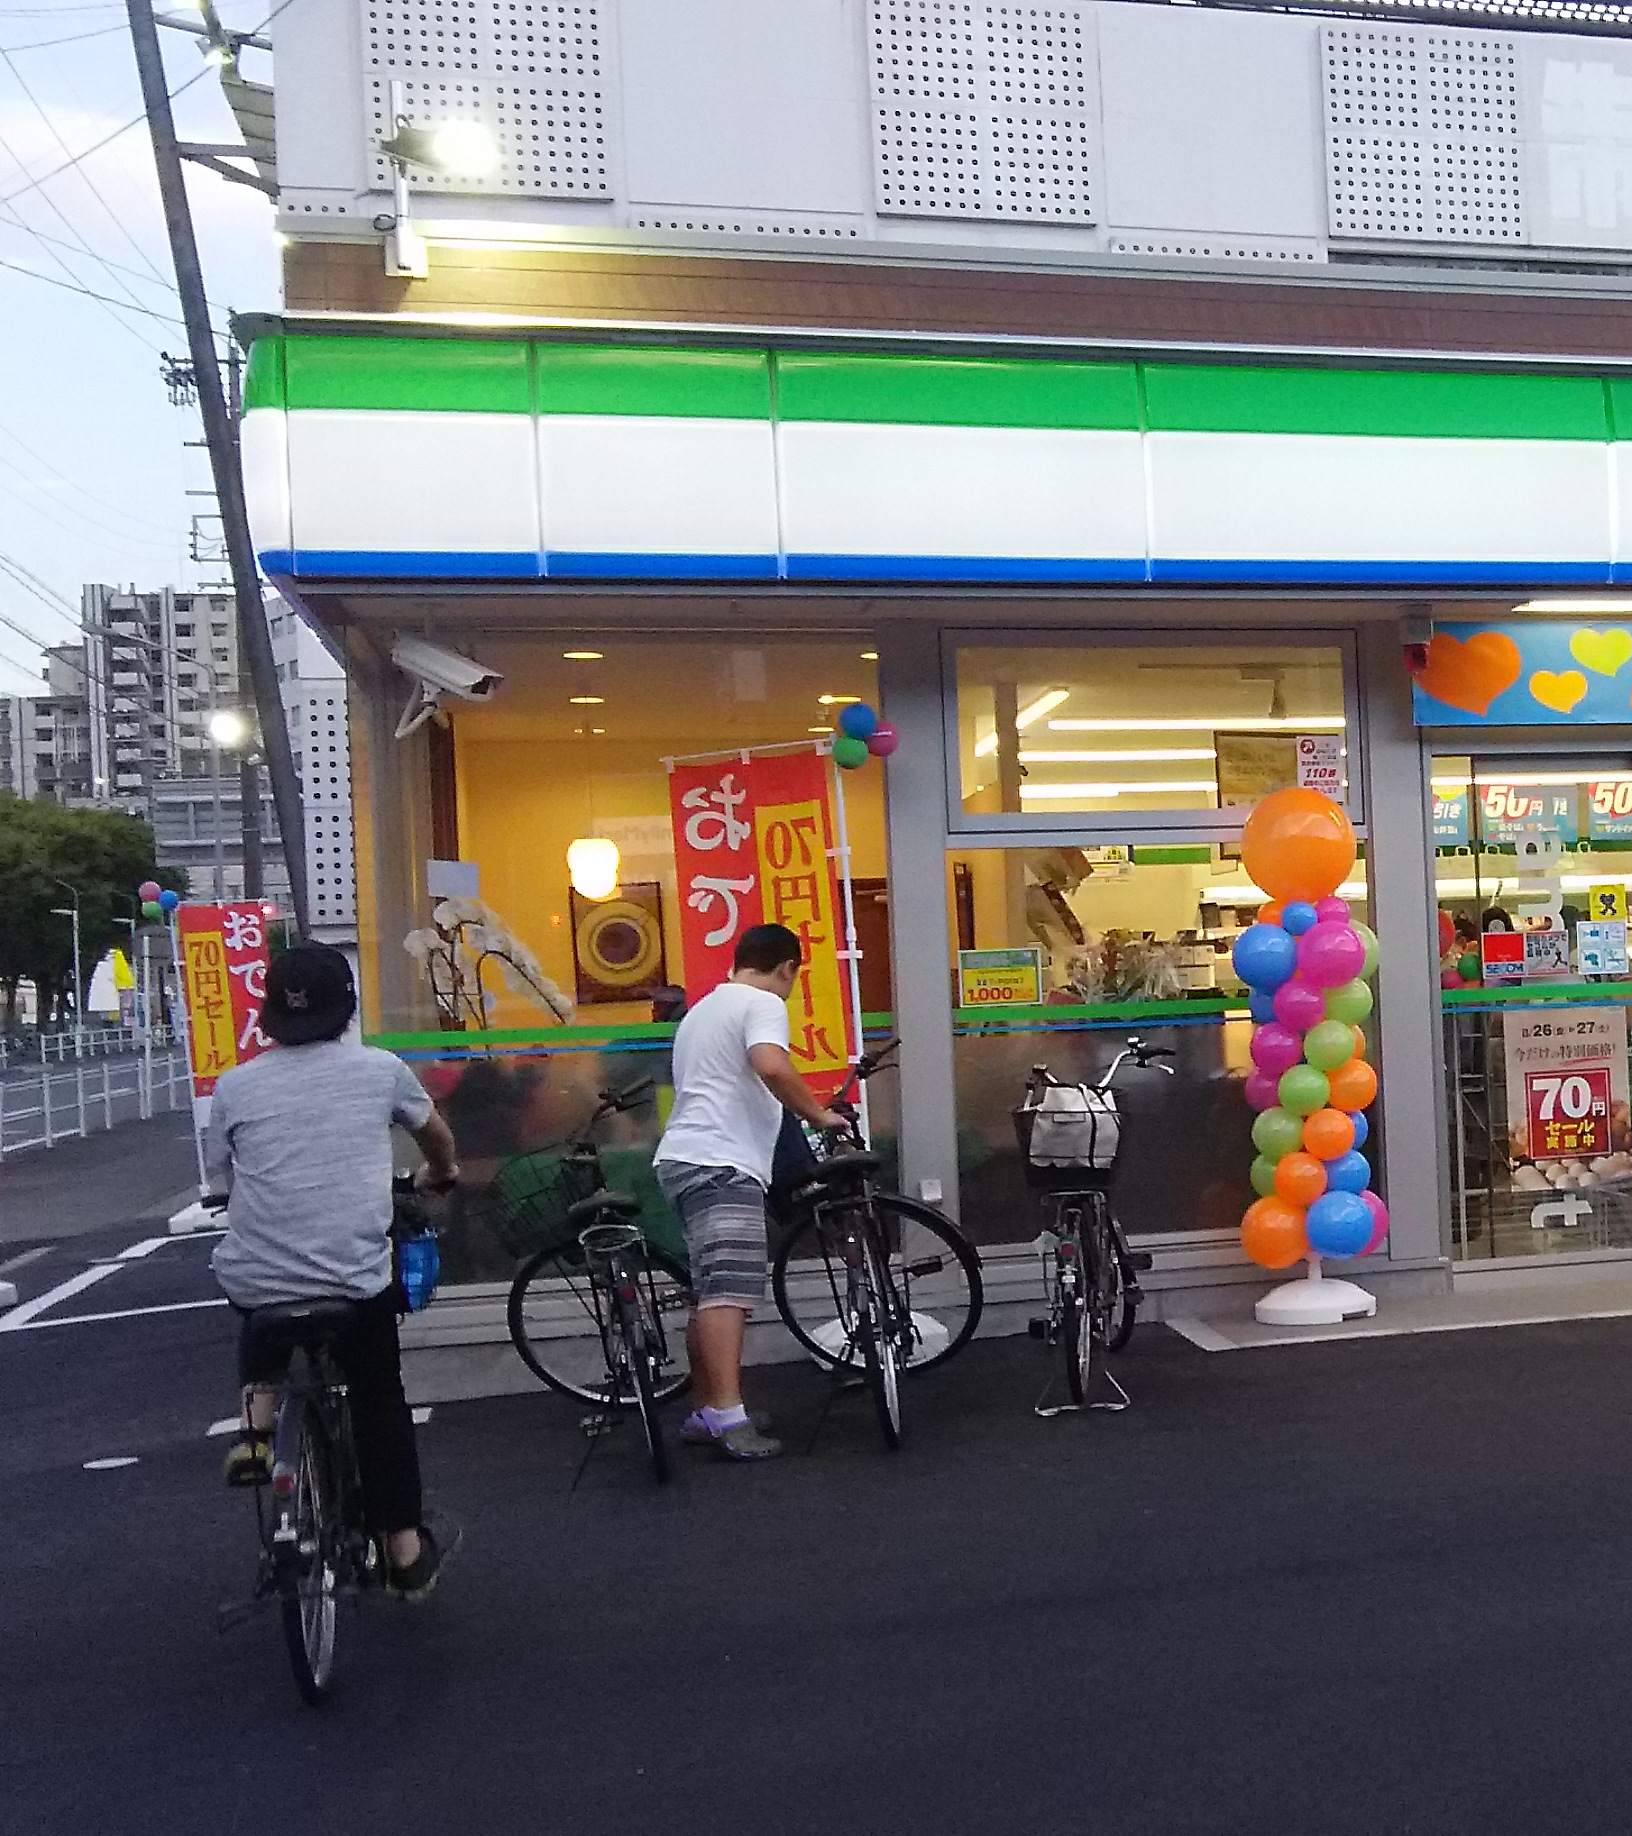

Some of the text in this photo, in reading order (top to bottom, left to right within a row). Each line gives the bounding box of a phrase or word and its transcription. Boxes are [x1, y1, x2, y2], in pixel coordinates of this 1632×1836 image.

[189, 940, 233, 1073] 70円セール
[223, 911, 275, 1050] おでん
[1532, 1076, 1606, 1120] 70円
[1545, 1119, 1595, 1135] セール
